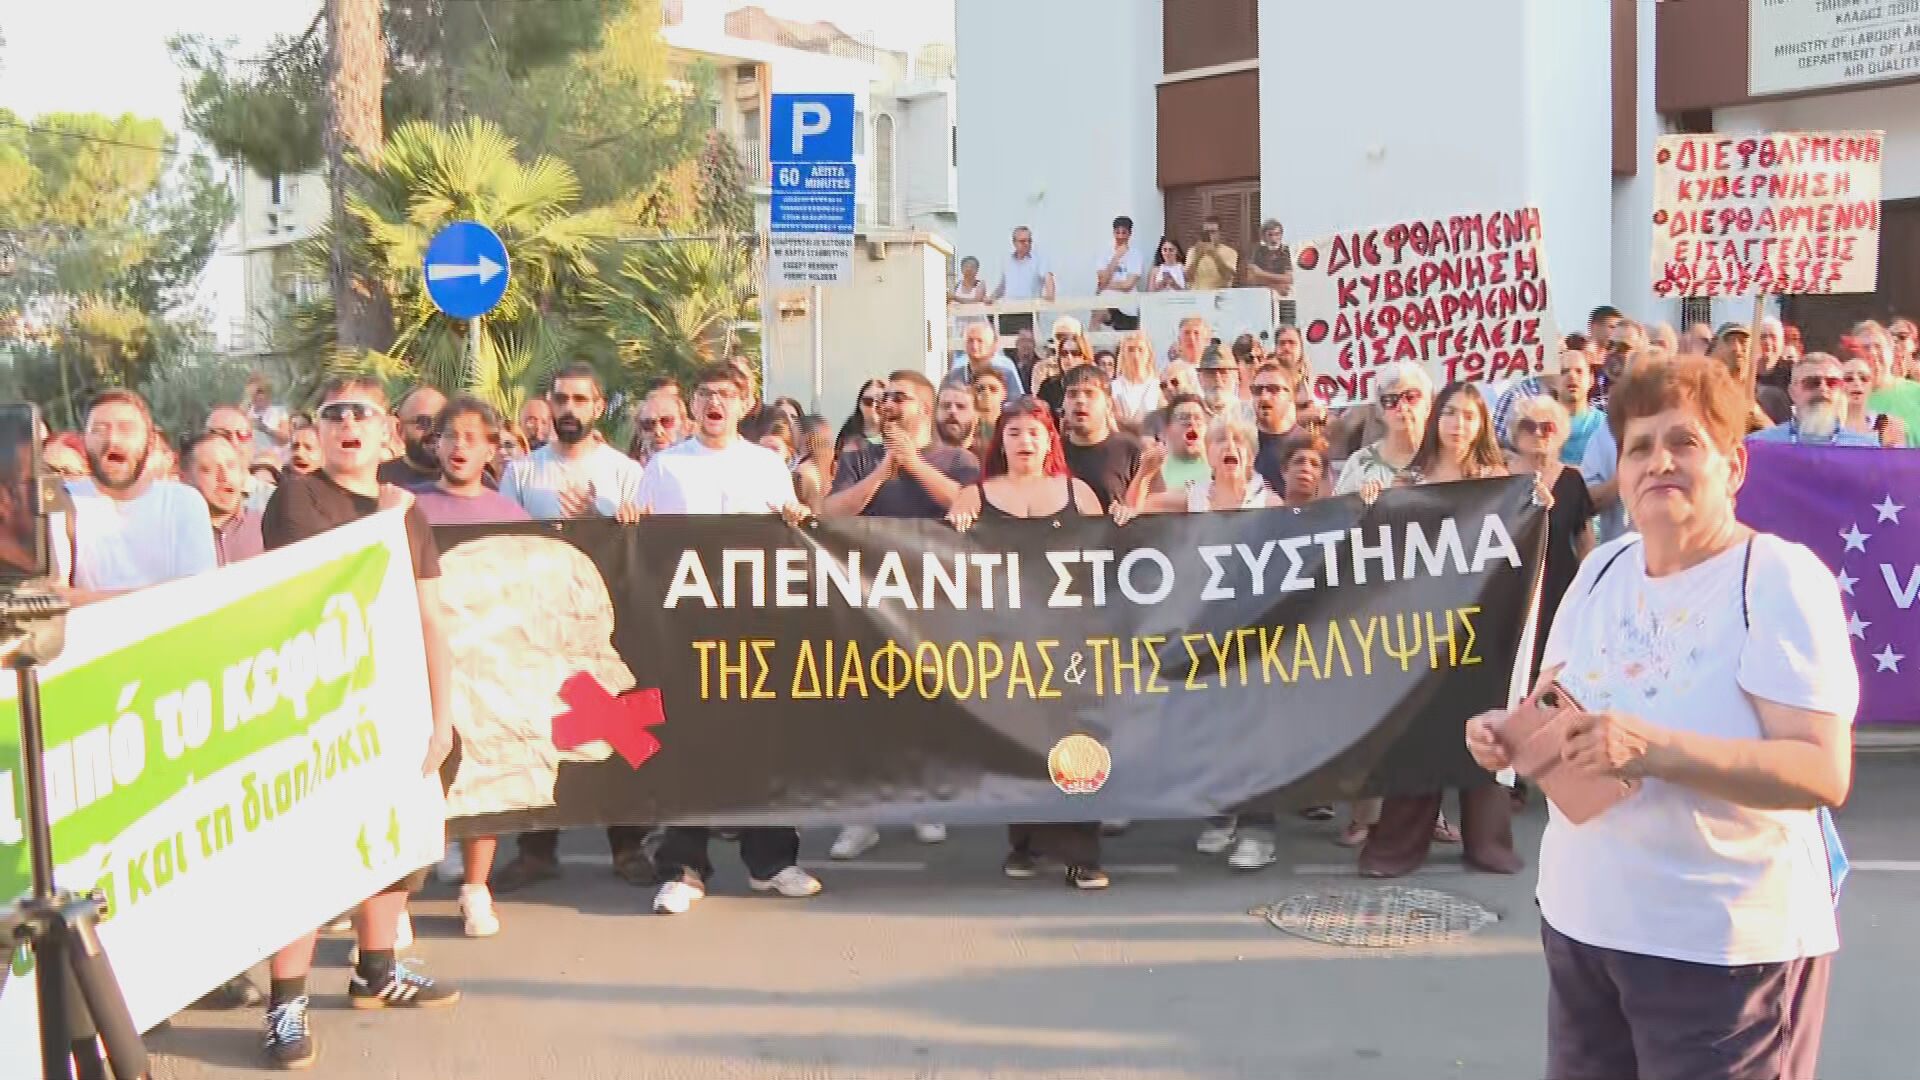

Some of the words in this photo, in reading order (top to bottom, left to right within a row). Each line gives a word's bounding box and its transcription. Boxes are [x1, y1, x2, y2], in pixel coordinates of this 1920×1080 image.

[1774, 38, 1829, 58] MINISTRY
[1831, 35, 1847, 49] OF
[1850, 27, 1901, 48] LABOUR
[1797, 47, 1876, 69] DEPARTMENT
[1879, 44, 1895, 57] OF
[1843, 63, 1864, 77] AIR
[1867, 55, 1920, 75] QUALITY
[791, 101, 832, 155] P
[810, 165, 845, 177] ΛΕΠΤΑ
[1675, 136, 1881, 173] ΔΙΕΦΘΑΡΜΕΝΗ
[779, 167, 800, 188] 60
[804, 177, 851, 190] MINUTES
[1677, 170, 1850, 202] ΚΥΒΕΡΝΗΣΗ
[1668, 199, 1878, 239] ΔΙΕΦΘΑΡΜΕΝΟΙ
[1326, 207, 1543, 277] ΔΙΕΦΘΑΡΜΕΝΗ
[1674, 235, 1857, 262] ΕΙΣΑΓΓΕΛΕΙΣ
[1336, 246, 1539, 309] ΚΥΒΕΡΝΗΣΗ
[1332, 278, 1548, 343] ΔΙΕΦΘΑΡΜΕΝΟΙ
[1338, 317, 1541, 371] ΕΙΣΑΓΓΕΛΕΙΣ
[662, 547, 1021, 609] ΑΠΕΝΑΝΤΙ
[1044, 546, 1176, 609] ΣΤΟ
[1198, 512, 1523, 603] ΣΥΣΤΗΜΑ
[1879, 563, 1920, 609] V
[691, 638, 777, 701] ΤΗΣ
[790, 637, 1061, 701] ΔΙΑΦΘΟΡΑΣ
[1063, 650, 1088, 686] &
[1085, 631, 1170, 697] ΤΗΣ
[1183, 604, 1484, 692] ΣΥΓΚΑΛΥΨΗΣ
[154, 681, 213, 761] το
[223, 592, 370, 733] κεφάλ
[126, 831, 189, 906] και
[194, 800, 235, 861] τη
